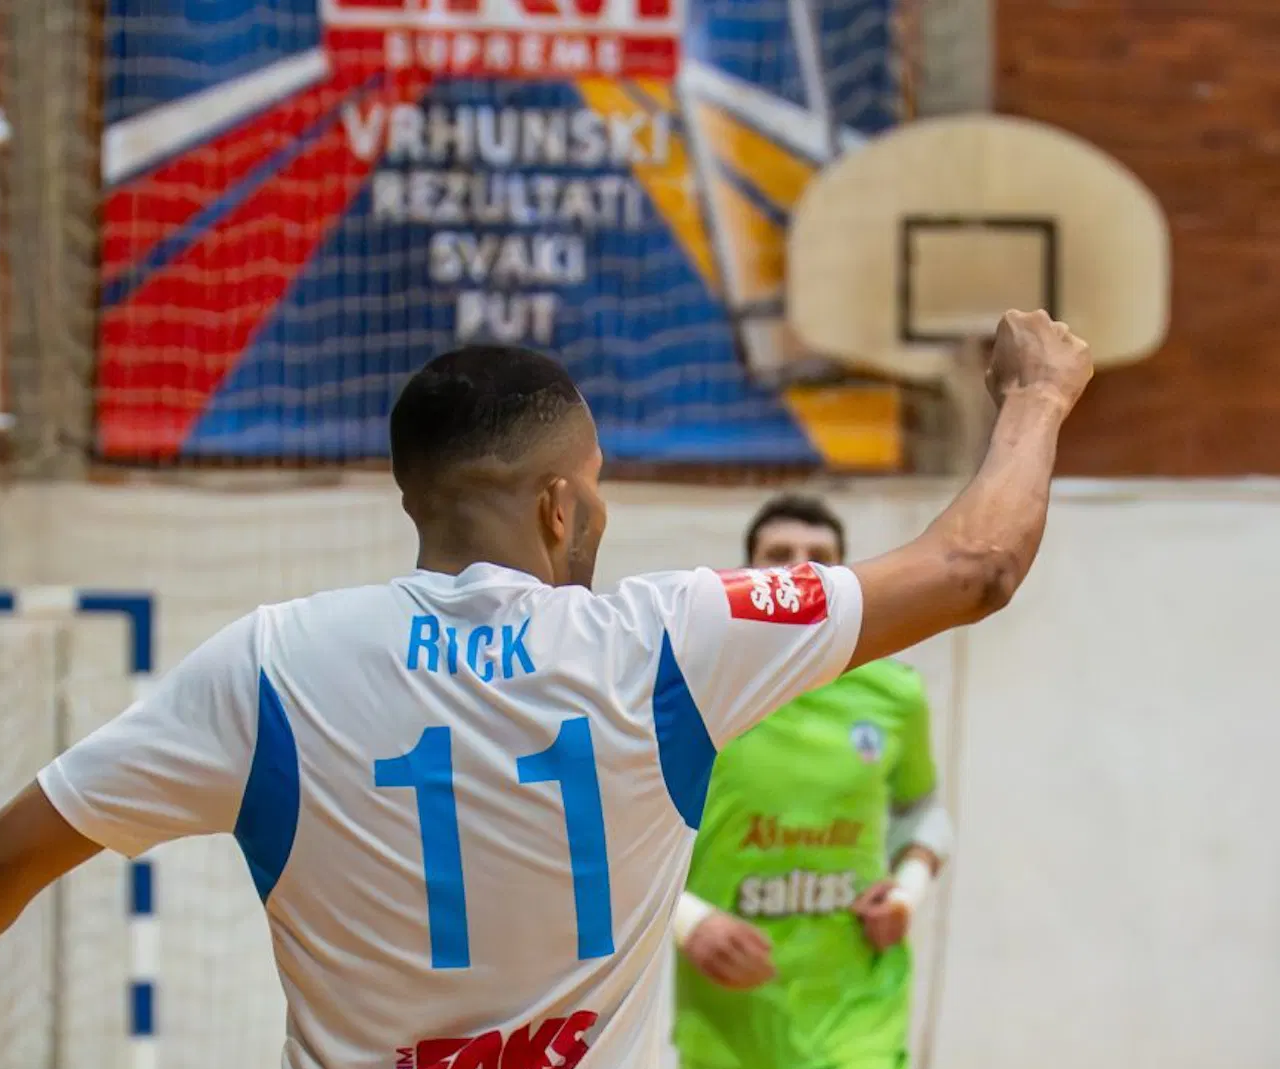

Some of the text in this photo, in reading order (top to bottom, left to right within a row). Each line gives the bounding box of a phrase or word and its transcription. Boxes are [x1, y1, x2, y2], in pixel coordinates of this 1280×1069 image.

[384, 28, 620, 73] SUPREME
[340, 103, 671, 167] VRHUNSKI
[372, 170, 645, 230] REZULTATI
[429, 232, 588, 284] SVAKI
[457, 291, 558, 343] PUT
[407, 614, 536, 683] RICK
[375, 717, 615, 968] 11
